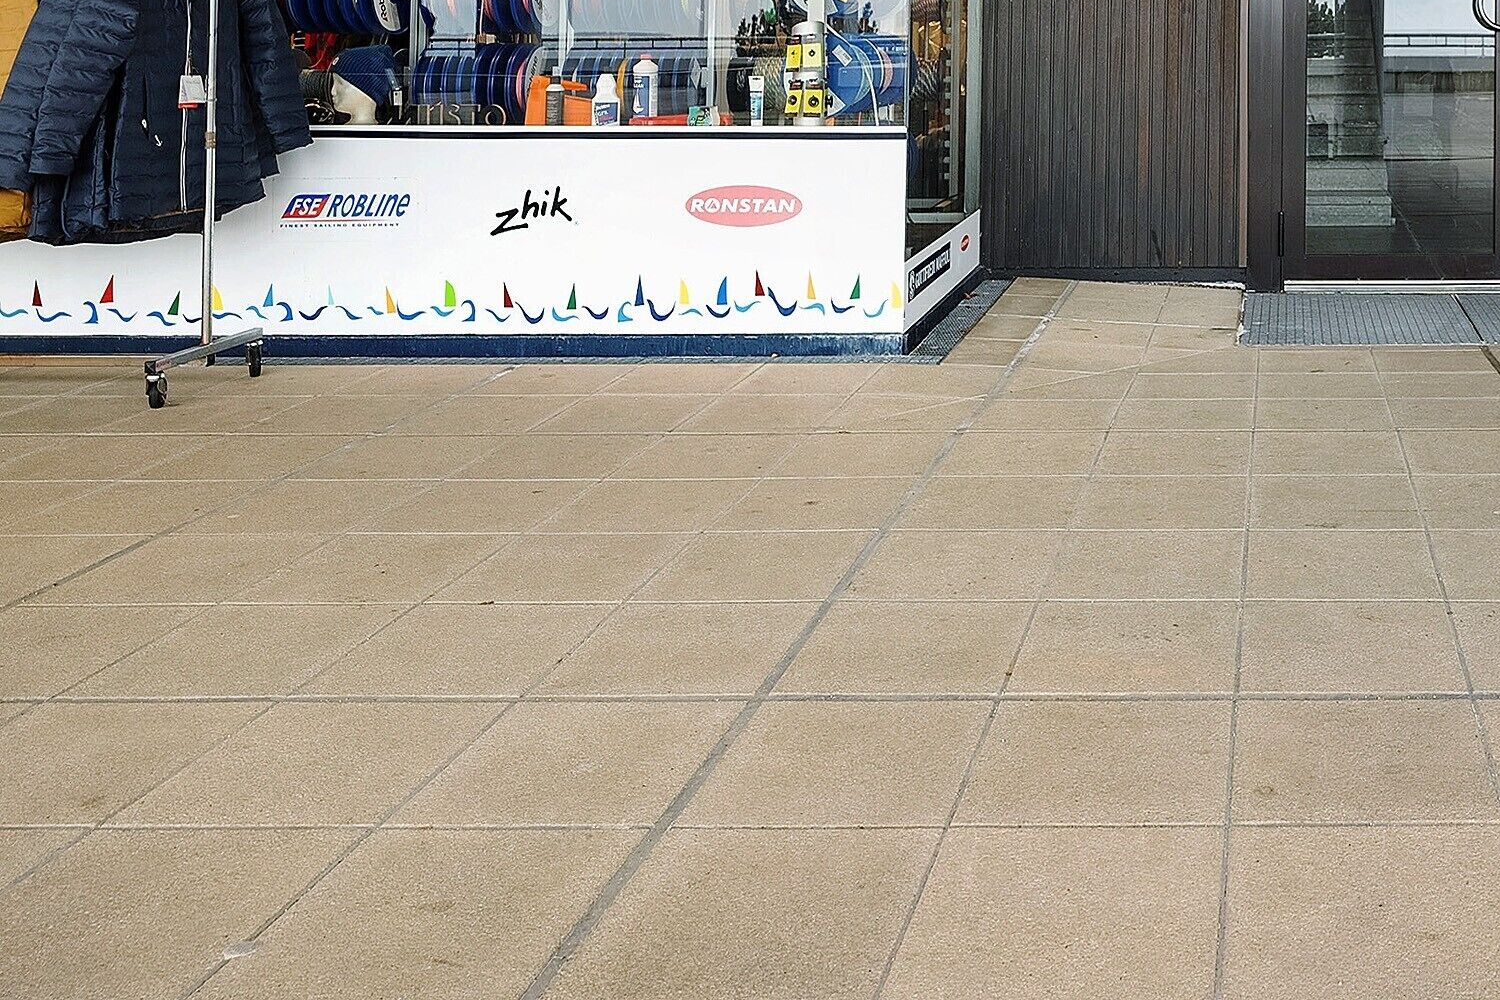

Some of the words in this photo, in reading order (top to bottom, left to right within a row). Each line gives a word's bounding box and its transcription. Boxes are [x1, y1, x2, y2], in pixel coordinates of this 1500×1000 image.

[290, 197, 322, 215] FSE
[490, 186, 573, 236] zhik
[690, 197, 797, 215] RONSTAN
